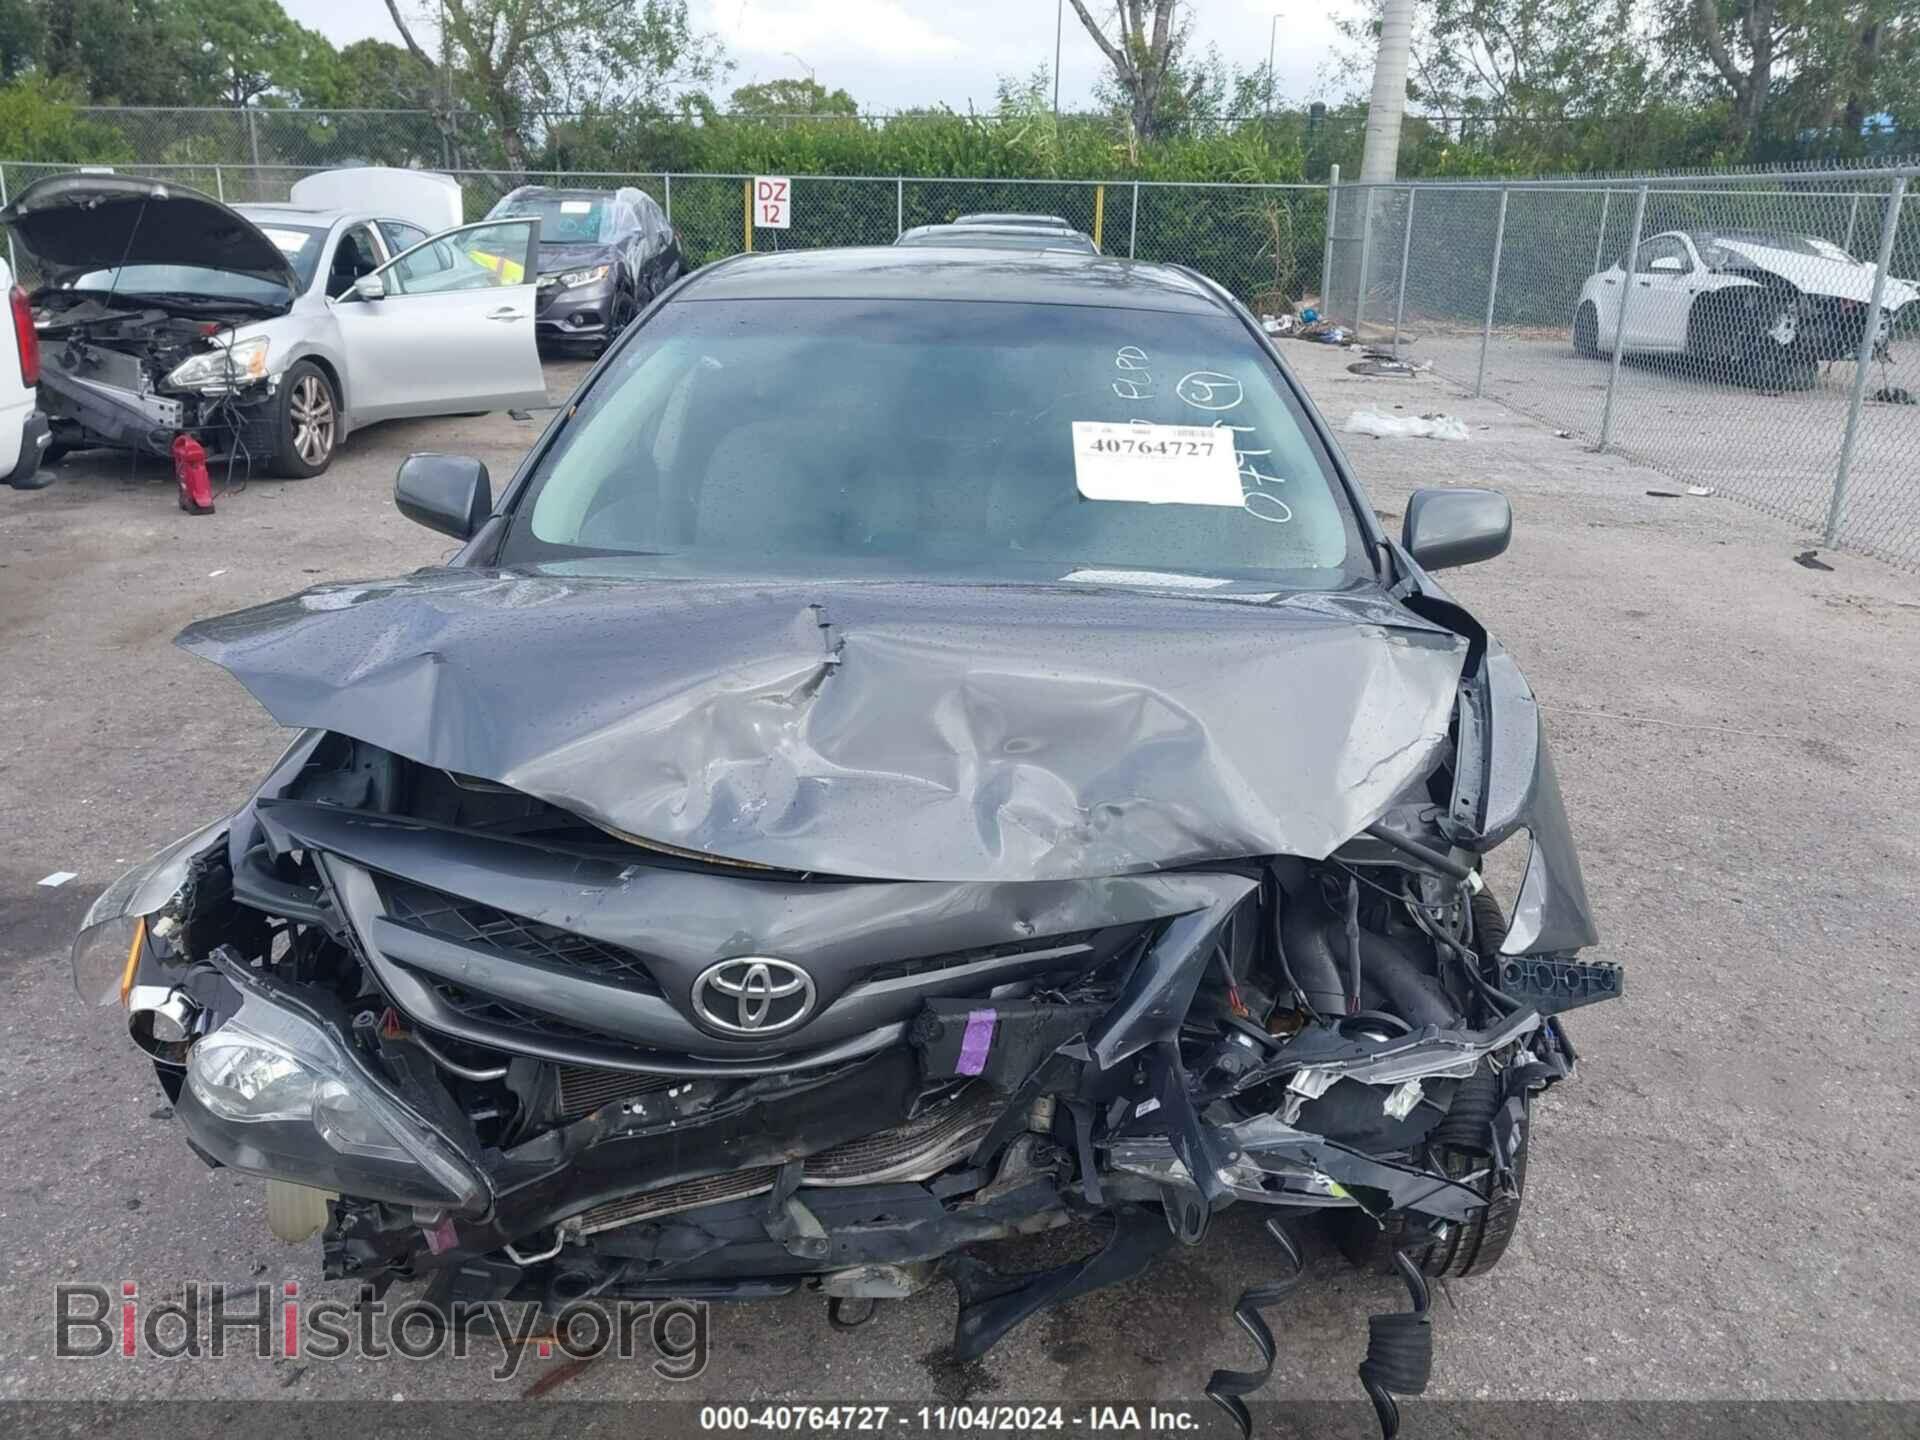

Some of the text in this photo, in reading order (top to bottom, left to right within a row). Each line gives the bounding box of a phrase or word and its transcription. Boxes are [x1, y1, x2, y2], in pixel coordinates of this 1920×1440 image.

[758, 181, 787, 202] DZ
[763, 204, 780, 223] 12
[1089, 438, 1215, 457] 40764727
